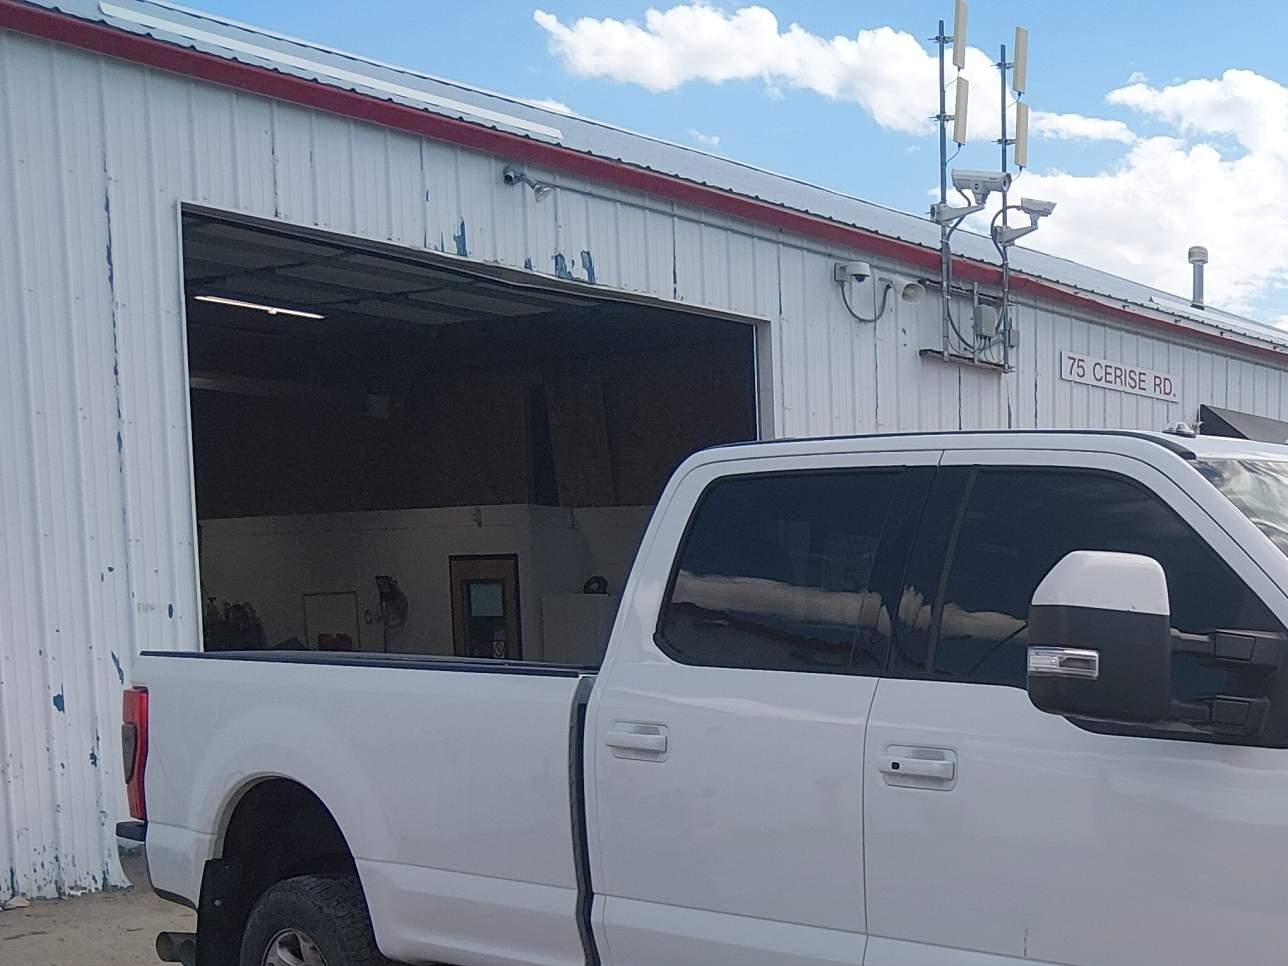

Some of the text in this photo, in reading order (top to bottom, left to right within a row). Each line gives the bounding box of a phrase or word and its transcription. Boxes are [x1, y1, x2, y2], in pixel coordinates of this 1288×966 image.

[1067, 356, 1177, 398] 75 CERISE RD.
